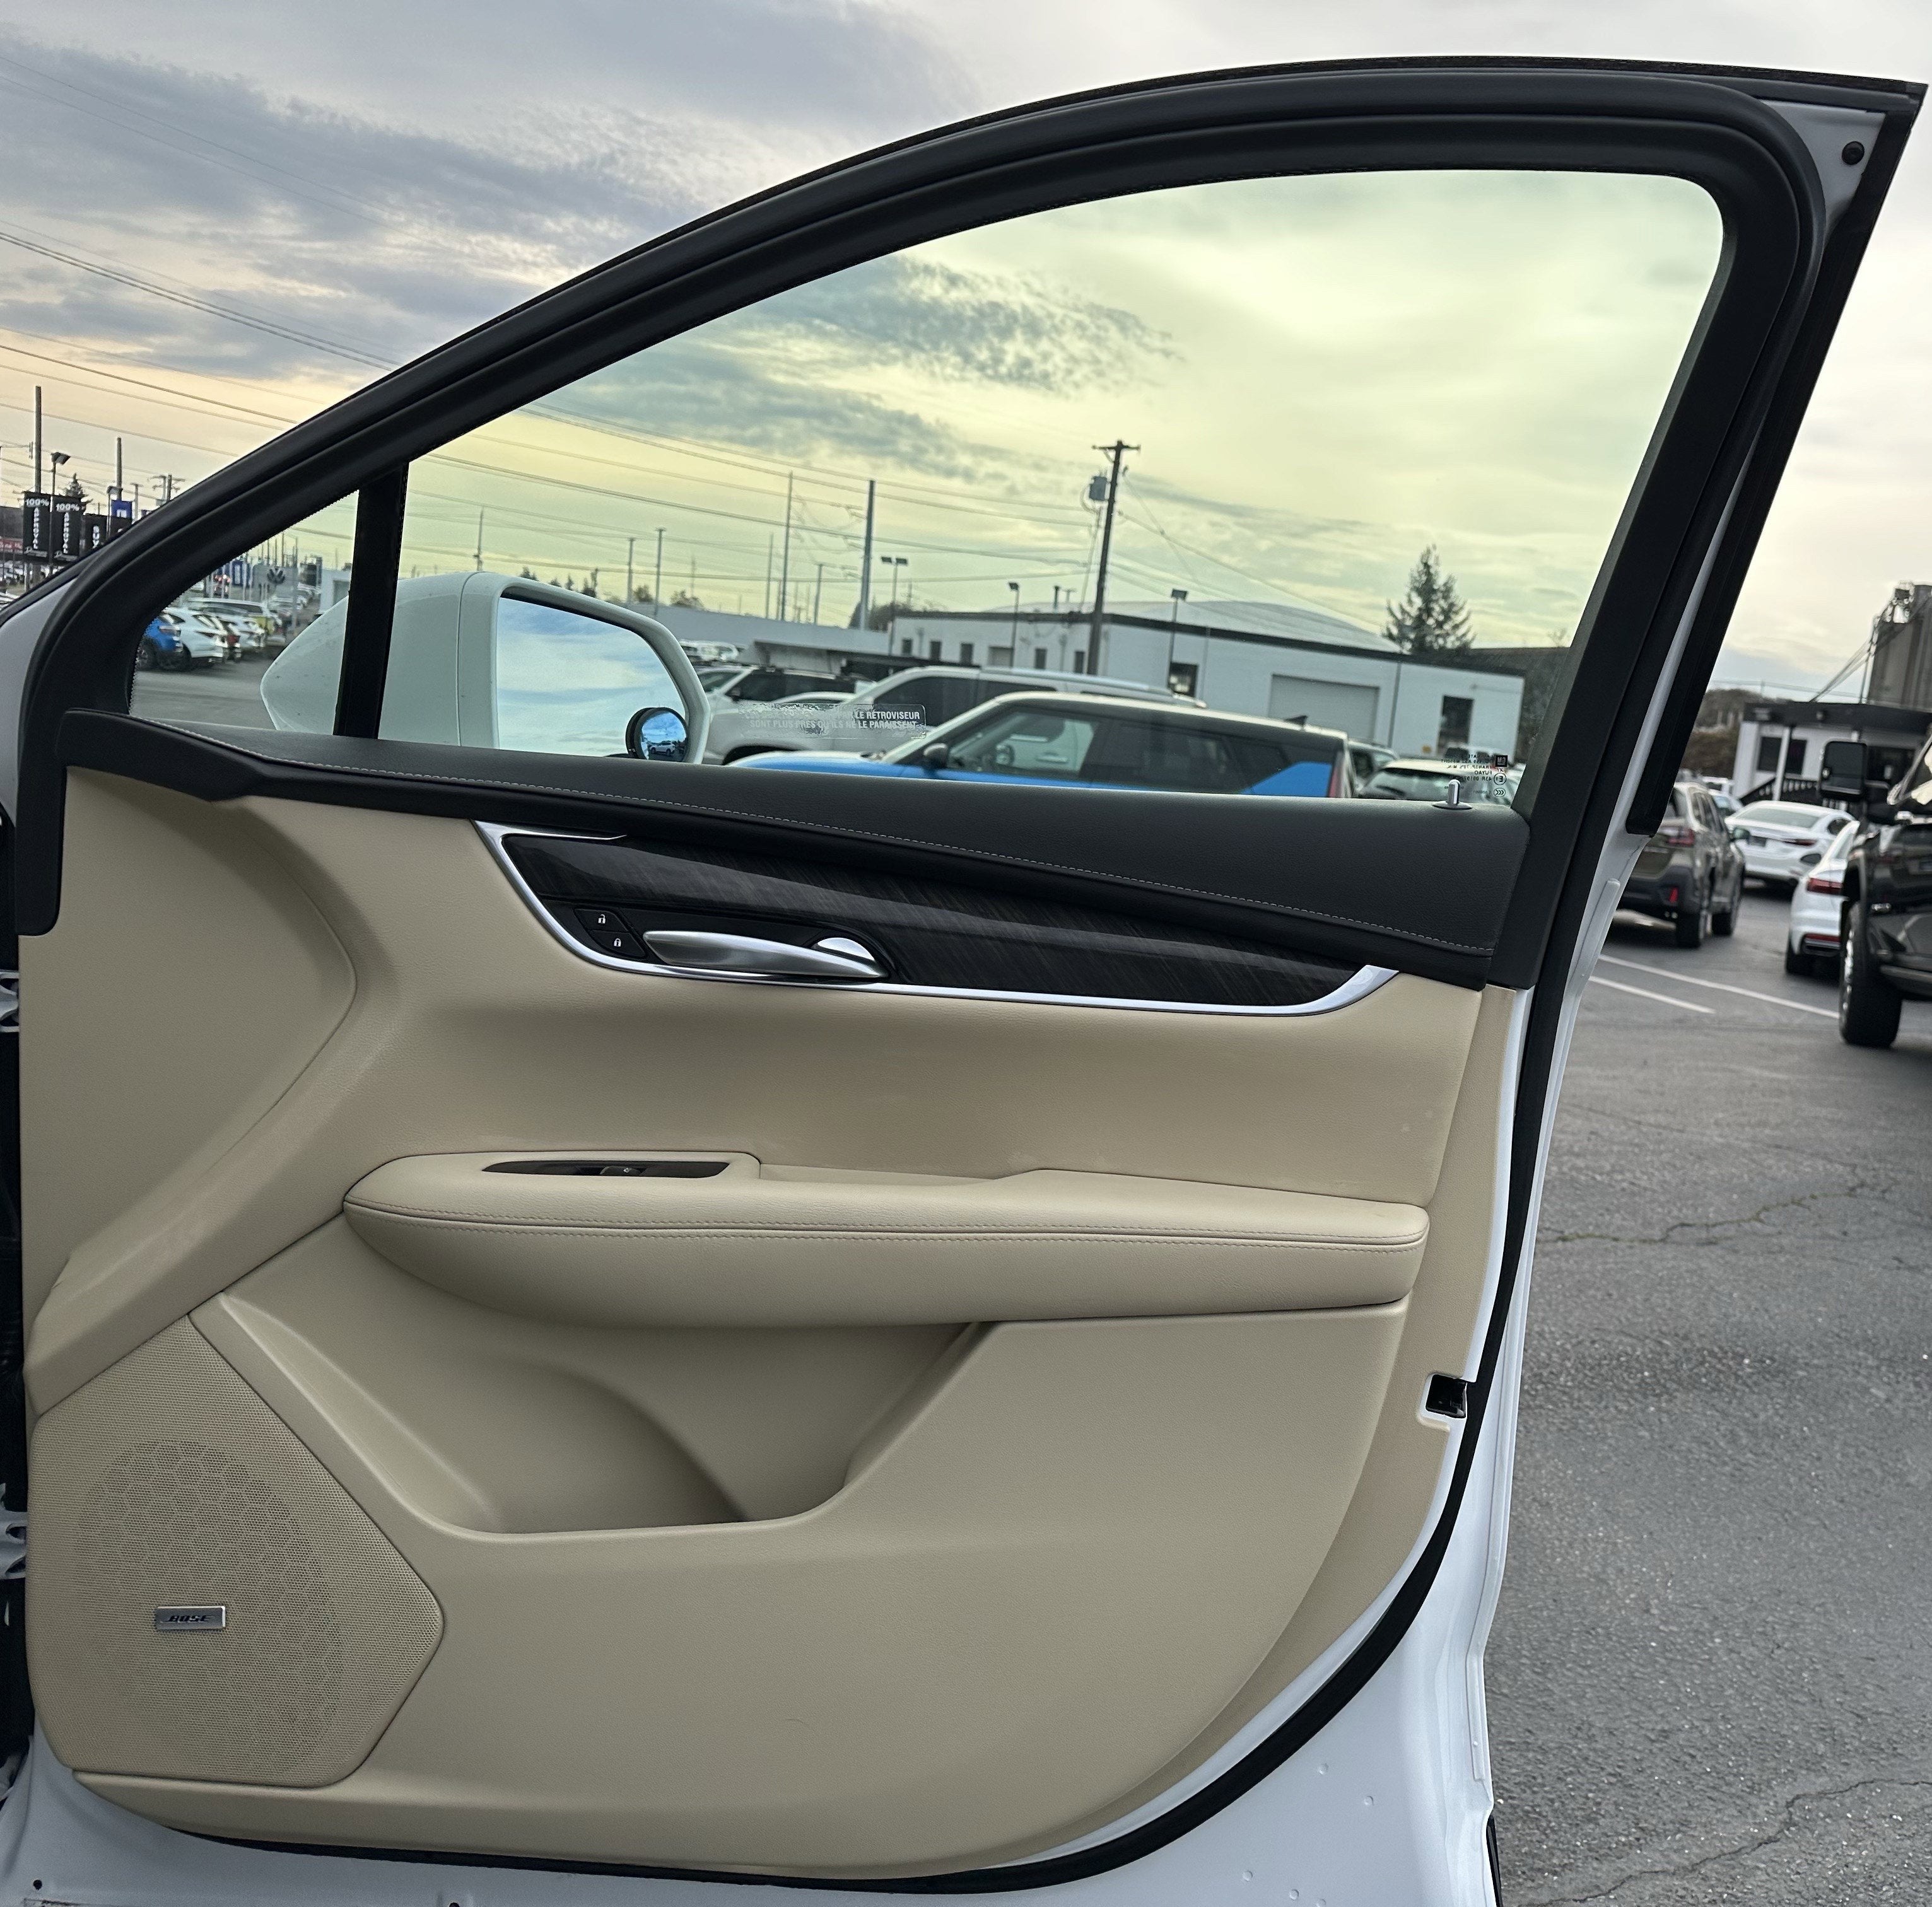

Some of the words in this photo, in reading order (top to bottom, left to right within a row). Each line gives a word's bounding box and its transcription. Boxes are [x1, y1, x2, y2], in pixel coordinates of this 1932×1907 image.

[56, 503, 79, 511] 100%
[867, 709, 920, 720] RÉTROVISEUR
[163, 1614, 213, 1623] BOSE
